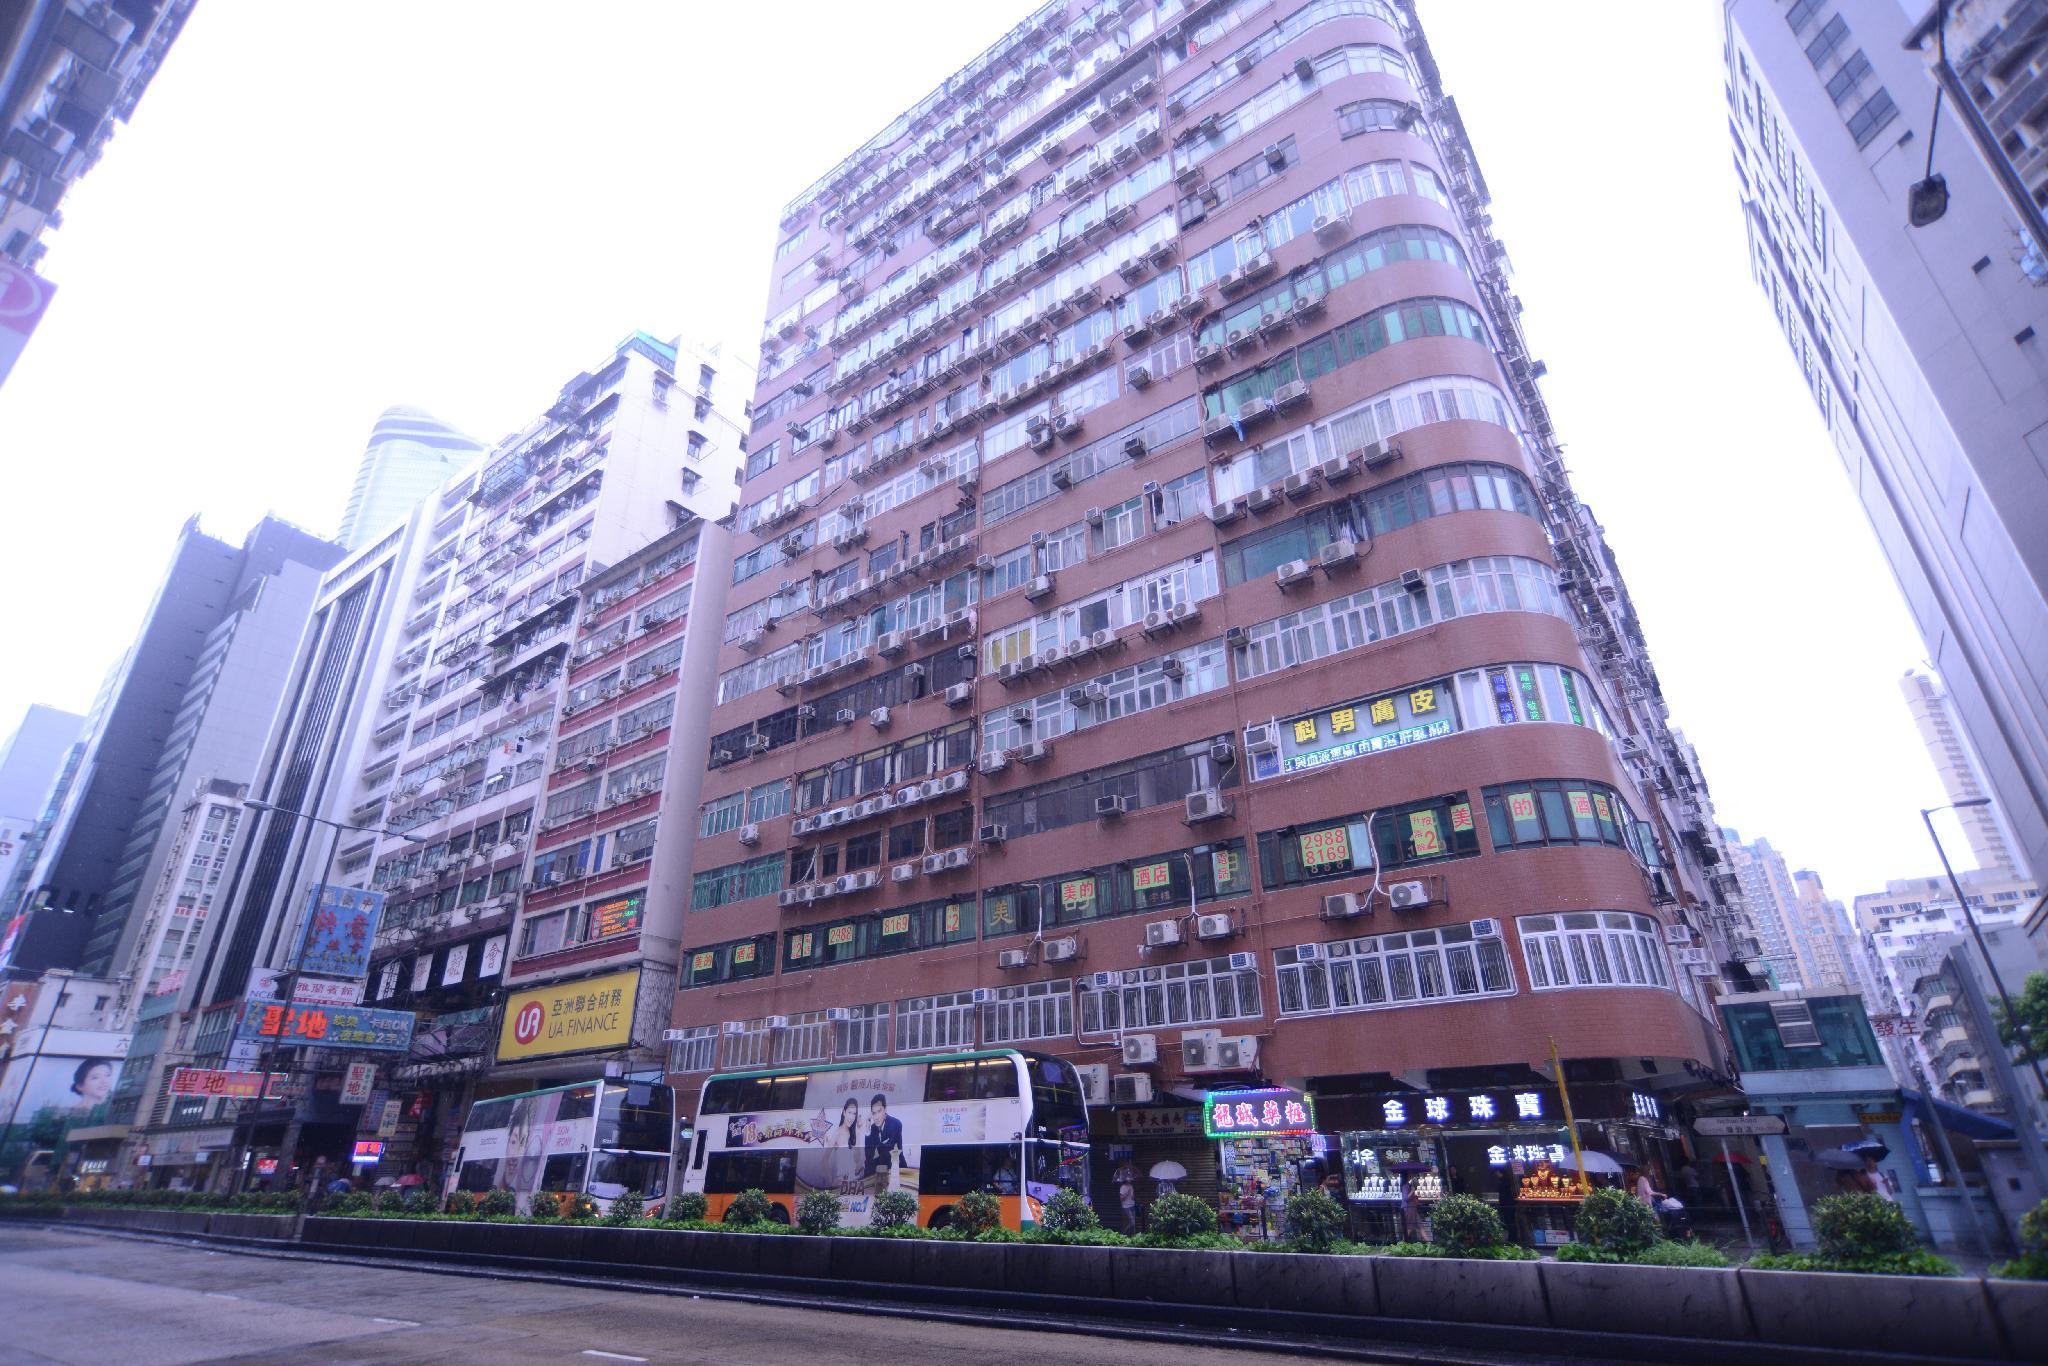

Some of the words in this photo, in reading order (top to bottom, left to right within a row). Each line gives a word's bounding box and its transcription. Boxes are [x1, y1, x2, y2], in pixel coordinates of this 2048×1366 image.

[1454, 807, 1472, 828] 美
[1511, 797, 1533, 816] 的
[1304, 828, 1344, 850] 2988
[1306, 845, 1346, 865] 8169
[1063, 882, 1093, 901] 美的
[1136, 865, 1168, 887] 酒店
[885, 916, 907, 933] 8169
[551, 989, 622, 1017] 亞洲聯合財務
[259, 1005, 329, 1039] 聖地
[549, 1020, 563, 1038] UA
[567, 1012, 619, 1037] FINANCE
[173, 1071, 227, 1094] 聖地
[346, 1066, 365, 1096] 聖地
[1382, 1092, 1541, 1123] 金球珠寶
[1385, 1149, 1410, 1160] Sale
[840, 1181, 865, 1196] DHA
